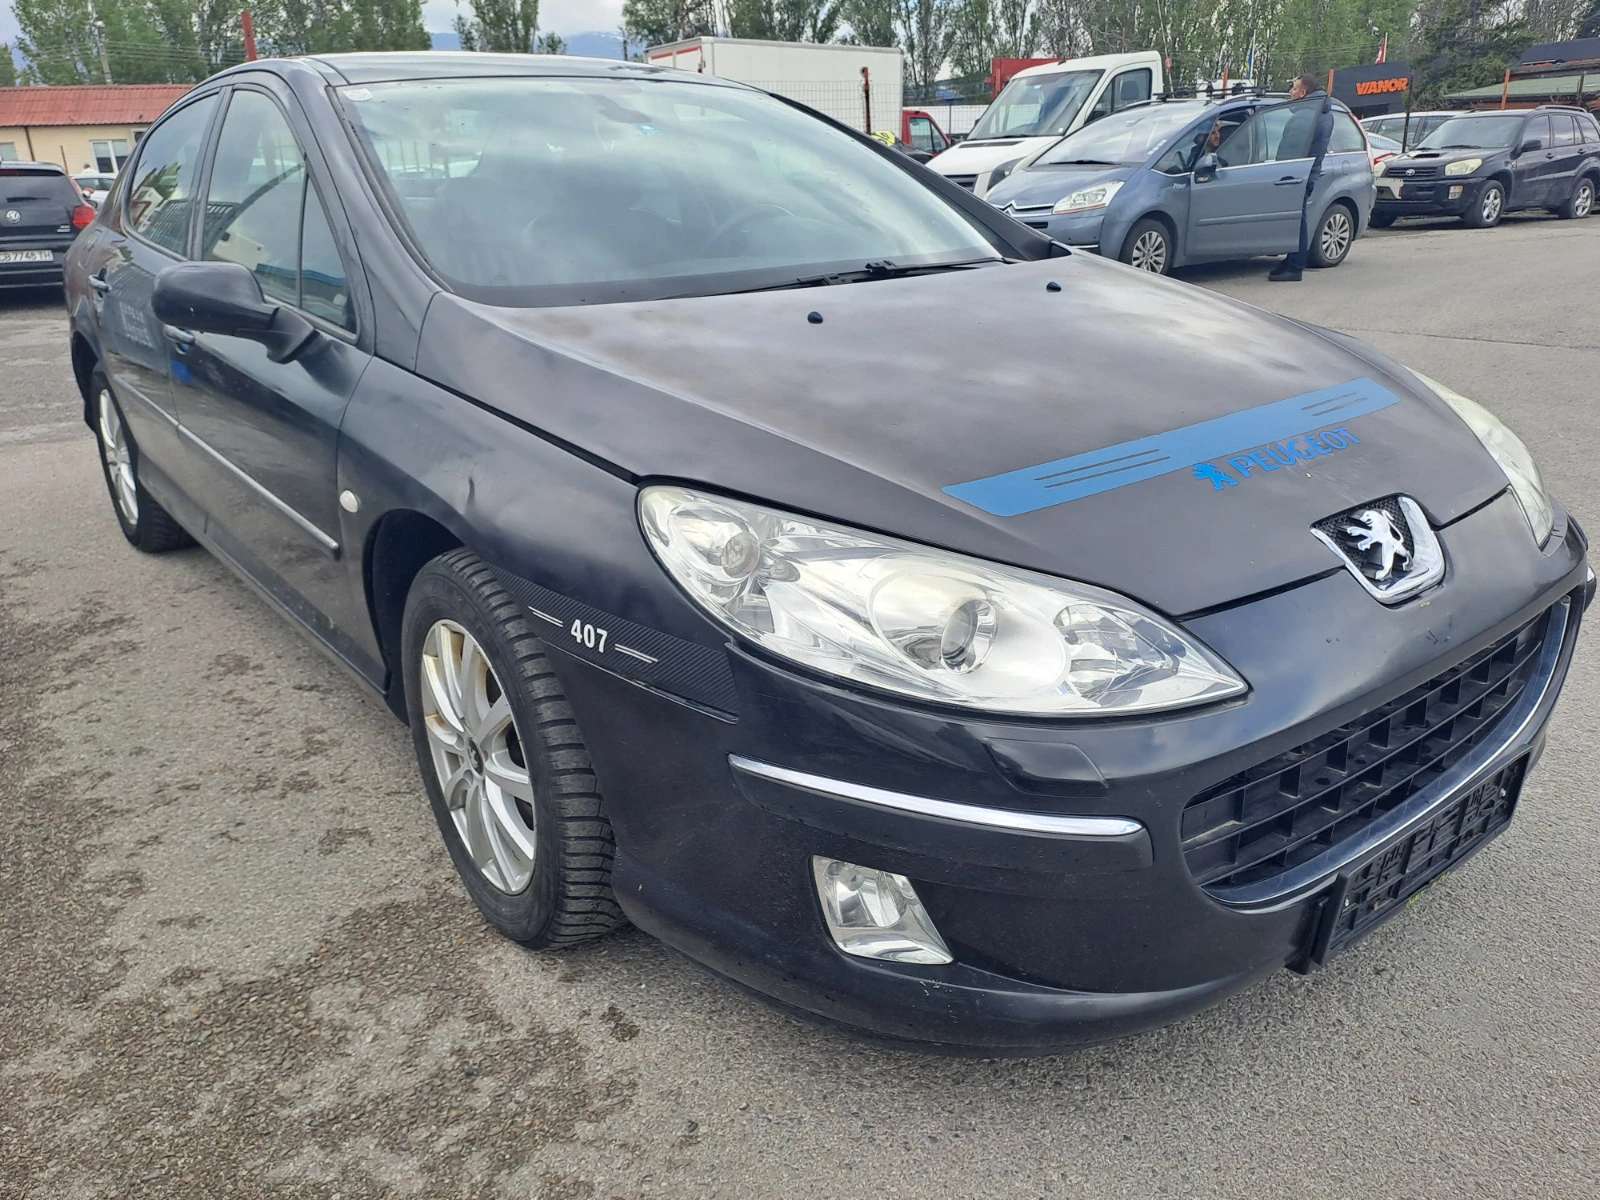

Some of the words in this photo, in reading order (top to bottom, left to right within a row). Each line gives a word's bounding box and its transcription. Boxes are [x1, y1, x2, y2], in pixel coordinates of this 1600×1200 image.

[1356, 77, 1408, 95] VIANOR
[1227, 427, 1361, 478] PEUGEOT
[570, 618, 608, 653] 407
